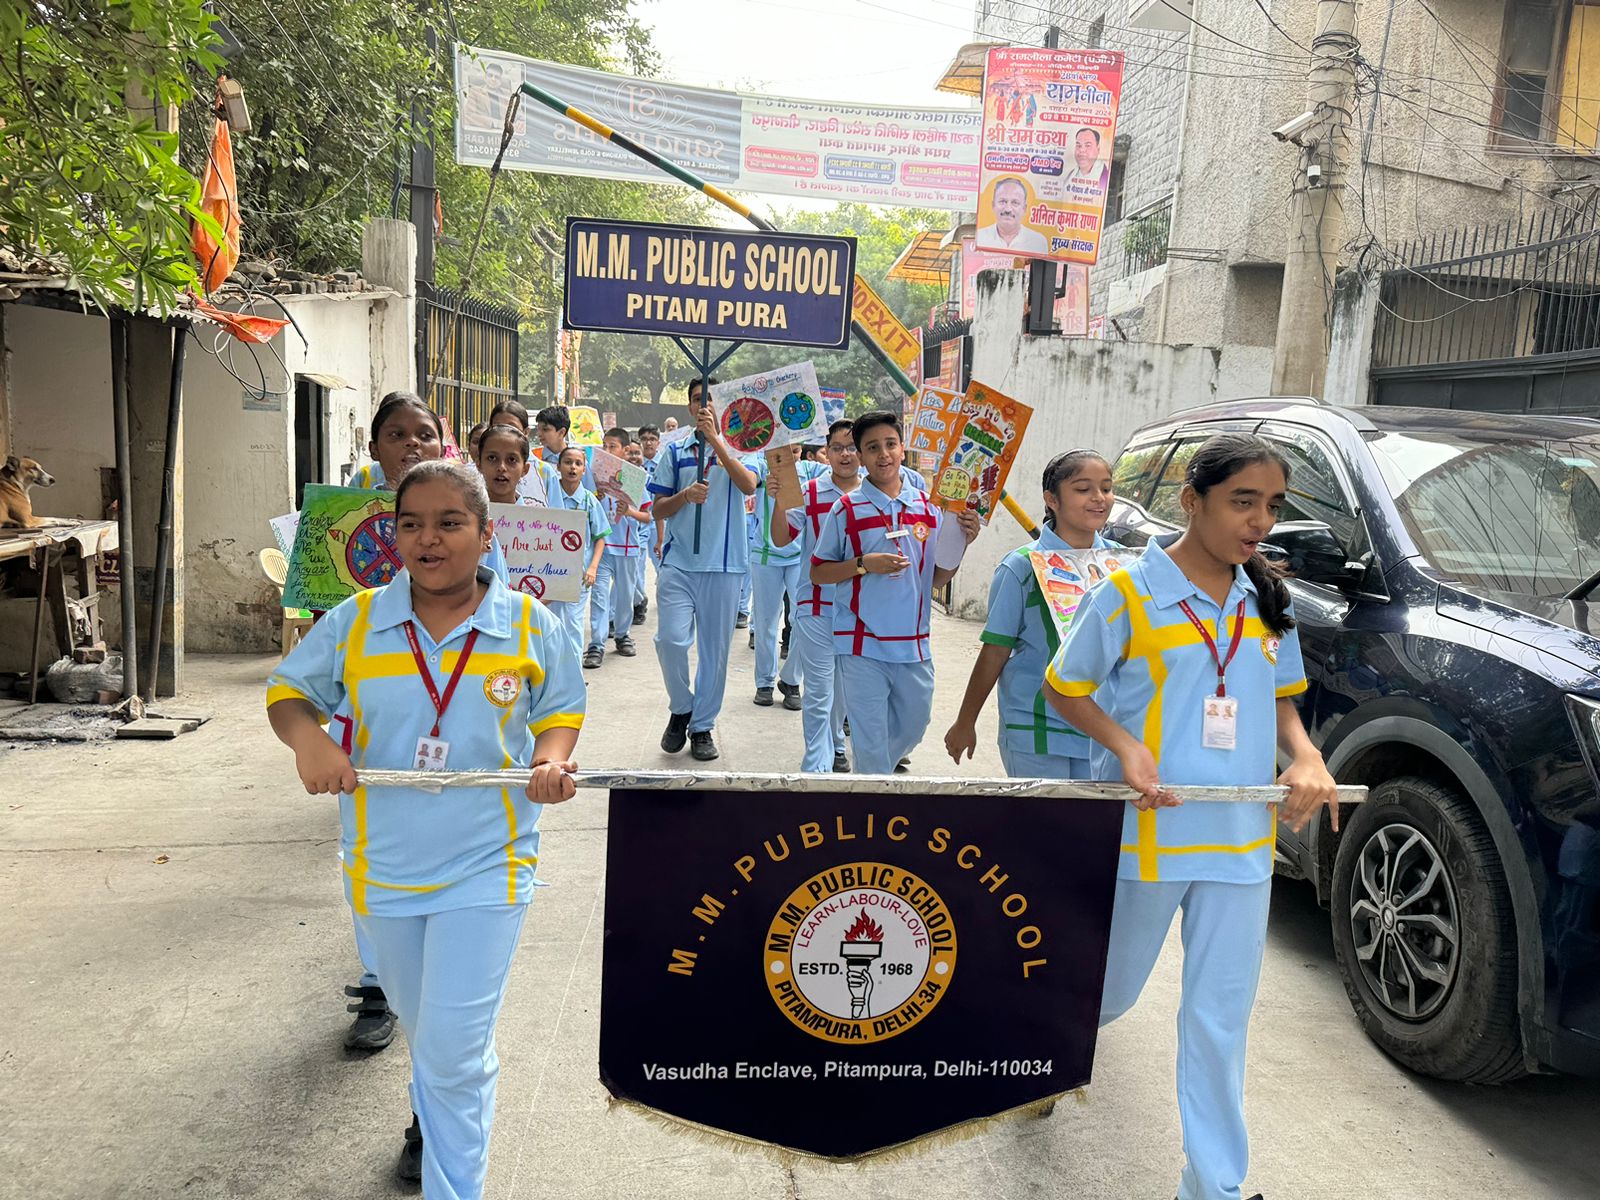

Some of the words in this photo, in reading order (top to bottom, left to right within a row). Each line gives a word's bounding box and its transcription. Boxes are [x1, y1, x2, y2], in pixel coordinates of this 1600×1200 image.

[1010, 52, 1051, 61] रामलीला
[987, 123, 1006, 145] श्री
[1008, 128, 1034, 145] राम
[1035, 129, 1068, 147] कथा
[1031, 158, 1049, 167] JMD
[1030, 204, 1056, 226] अनिल
[1057, 209, 1078, 233] कुमार
[1079, 213, 1098, 231] राणा
[576, 231, 637, 280] M.M.
[646, 236, 736, 289] PUBLIC
[744, 243, 842, 296] SCHOOL
[626, 293, 708, 325] PITAM
[717, 297, 788, 329] PURA
[512, 536, 530, 552] Are
[533, 537, 554, 552] Just
[538, 562, 569, 576] Abuse
[734, 813, 910, 884] PUBLIC
[927, 826, 1049, 980] SCHOOL
[768, 902, 810, 953] M.M.
[806, 866, 894, 902] PUBLIC
[897, 876, 954, 956] SCHOOL
[799, 962, 844, 976] ESTD.
[880, 963, 913, 976] 1968
[774, 979, 868, 1041] PITAMPURA,
[873, 980, 942, 1037] DELHI-34
[642, 1062, 729, 1081] Vasudha
[735, 1061, 817, 1081] Enclave,
[824, 1060, 928, 1081] Pitampura,
[933, 1059, 1053, 1078] Delhi-110034
